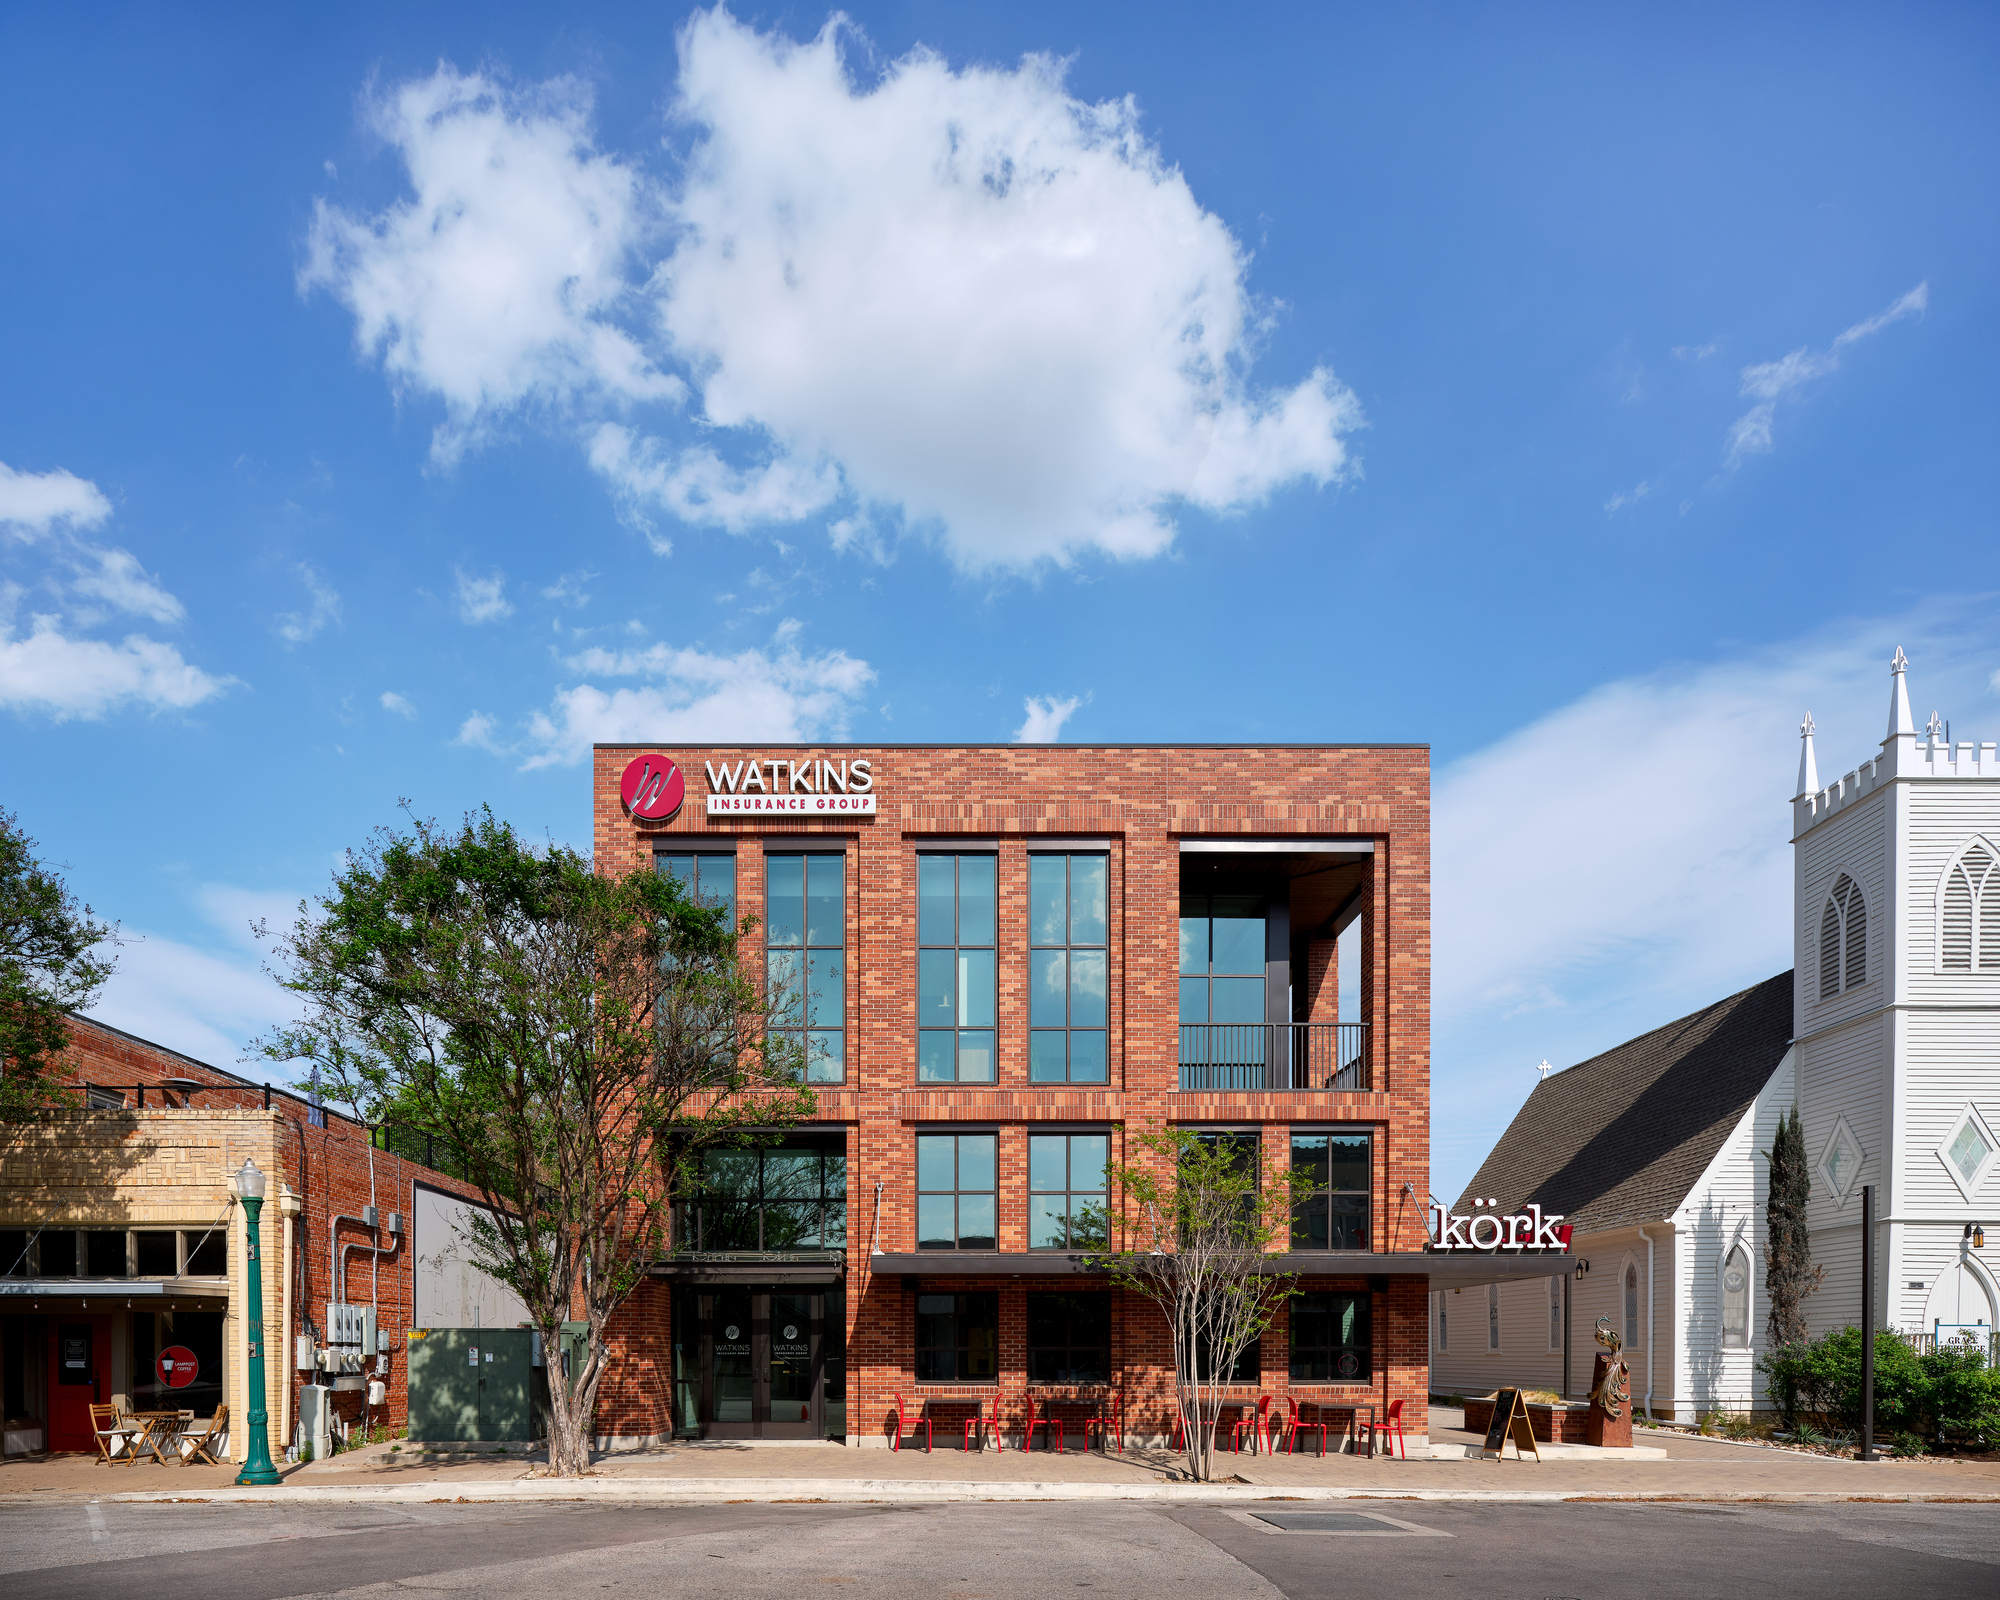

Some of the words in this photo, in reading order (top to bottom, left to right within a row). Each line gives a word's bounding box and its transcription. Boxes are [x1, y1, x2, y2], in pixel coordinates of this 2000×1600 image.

[705, 760, 873, 793] WATKINS
[714, 798, 806, 810] INSURANCE
[816, 798, 870, 810] GROUP
[1432, 1198, 1567, 1249] körk
